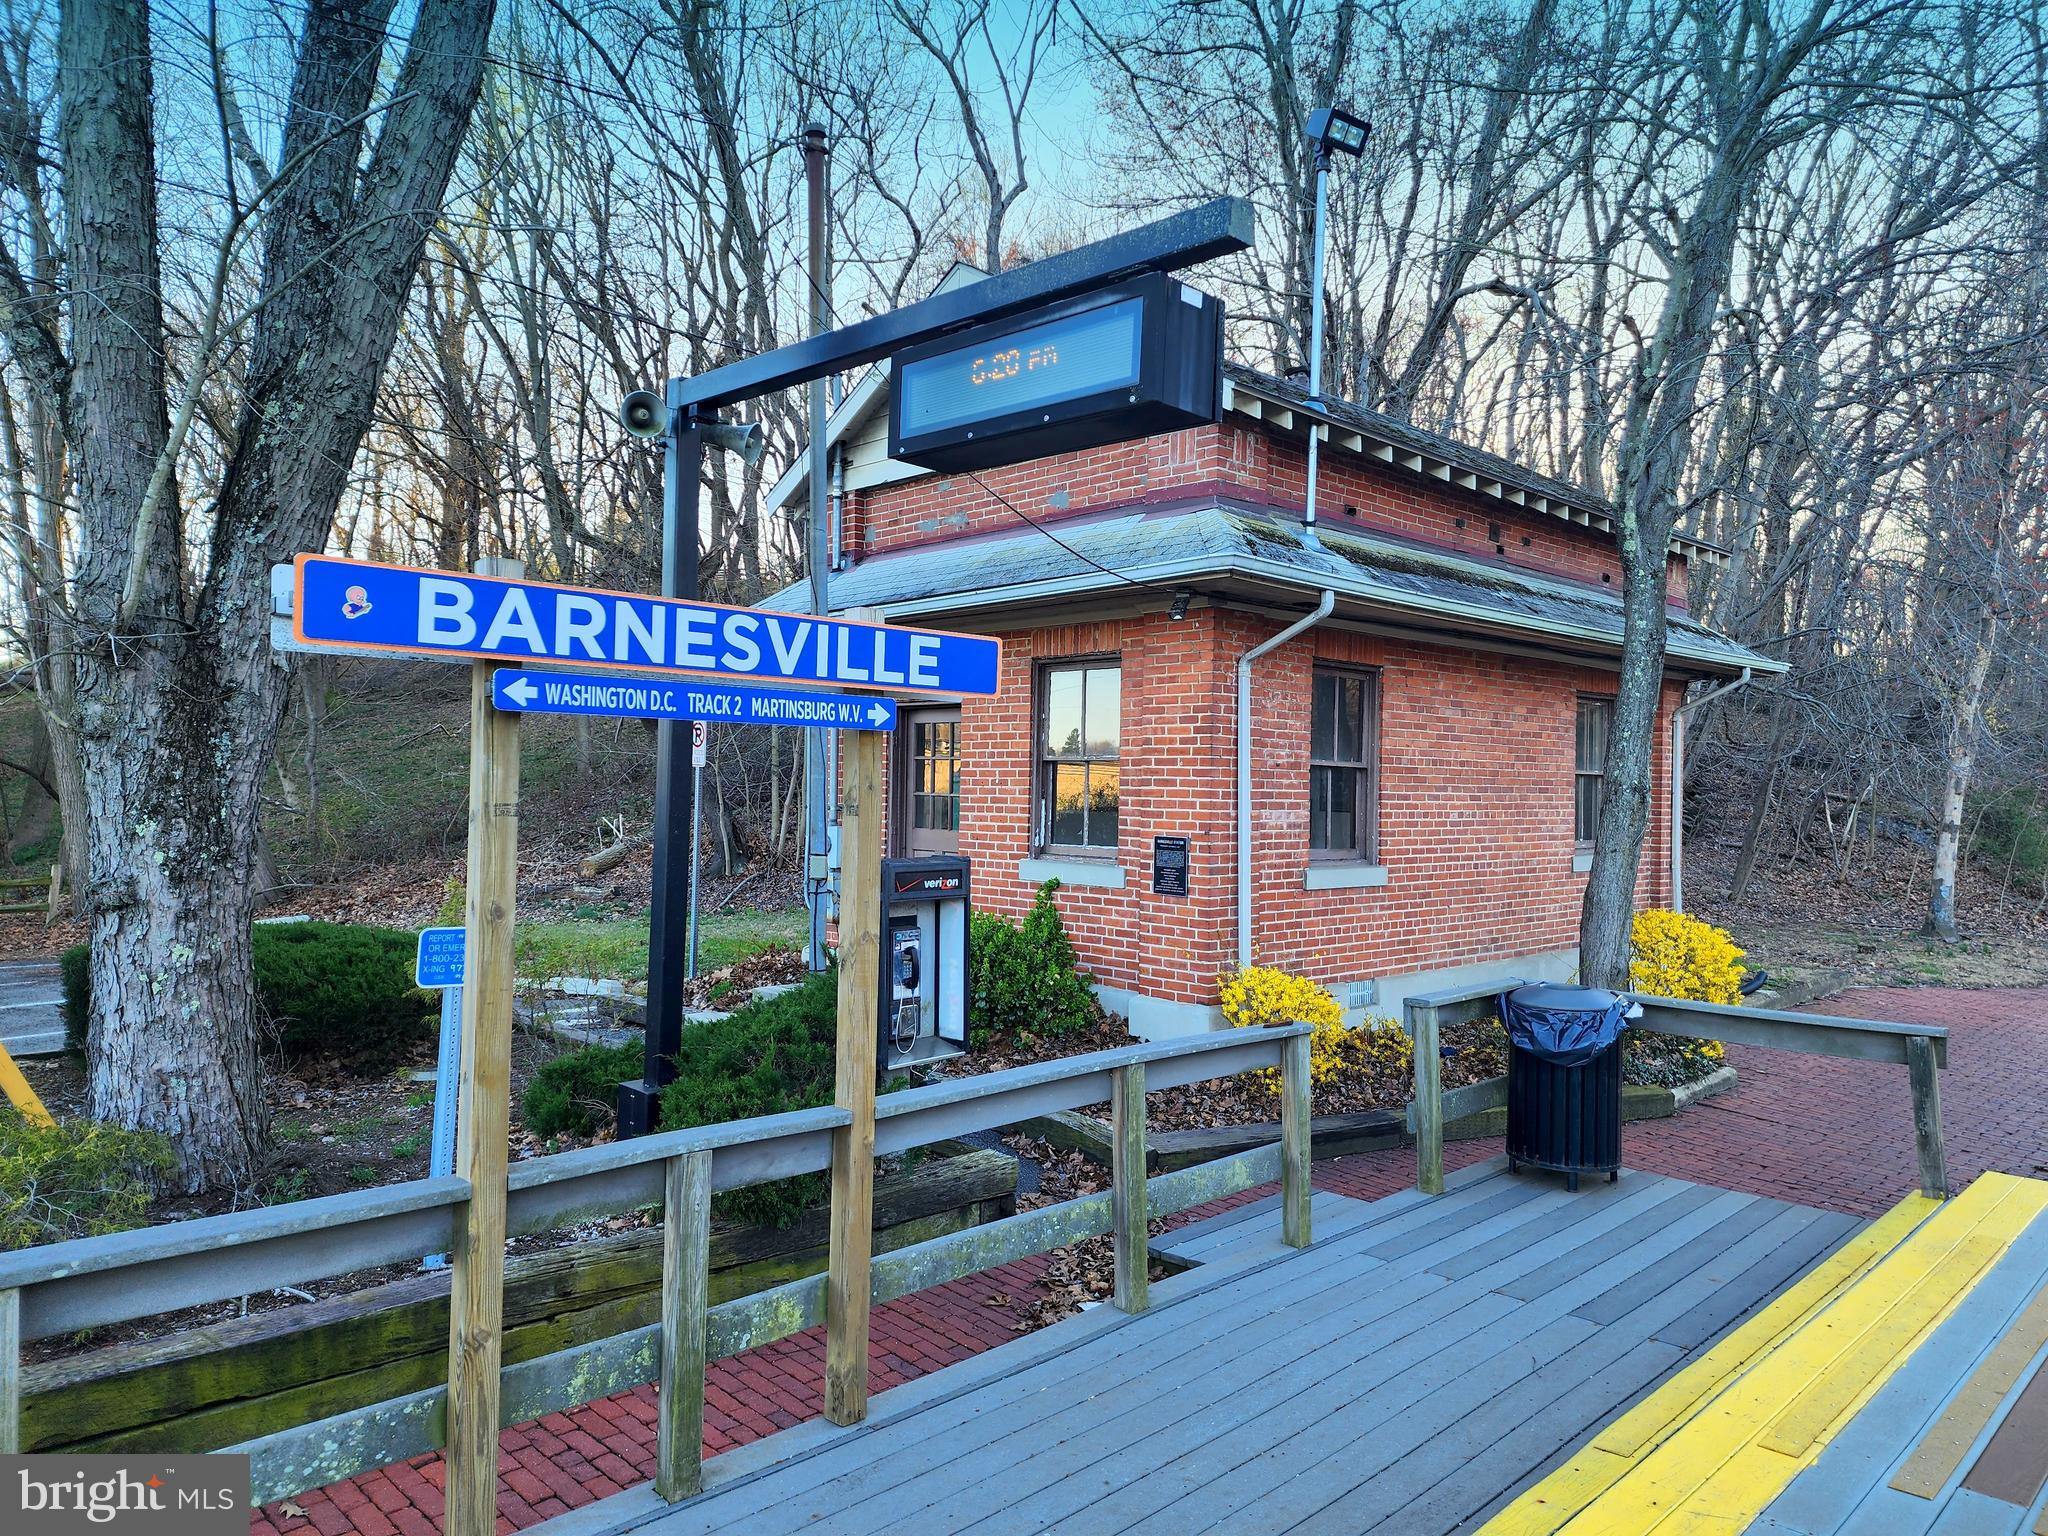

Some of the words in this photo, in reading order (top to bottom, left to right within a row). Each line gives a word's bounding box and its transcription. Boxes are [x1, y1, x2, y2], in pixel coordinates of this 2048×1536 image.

[417, 577, 942, 687] BARNESVILLE
[545, 683, 647, 710] WASHINGTON
[650, 690, 678, 712] D.C.
[687, 693, 732, 715] TRACK
[733, 696, 742, 716] 2
[751, 697, 836, 721] MARTINSBURG
[838, 703, 863, 723] W.V.
[924, 876, 959, 889] verizon
[428, 934, 455, 942] REPORT
[428, 944, 441, 952] OR
